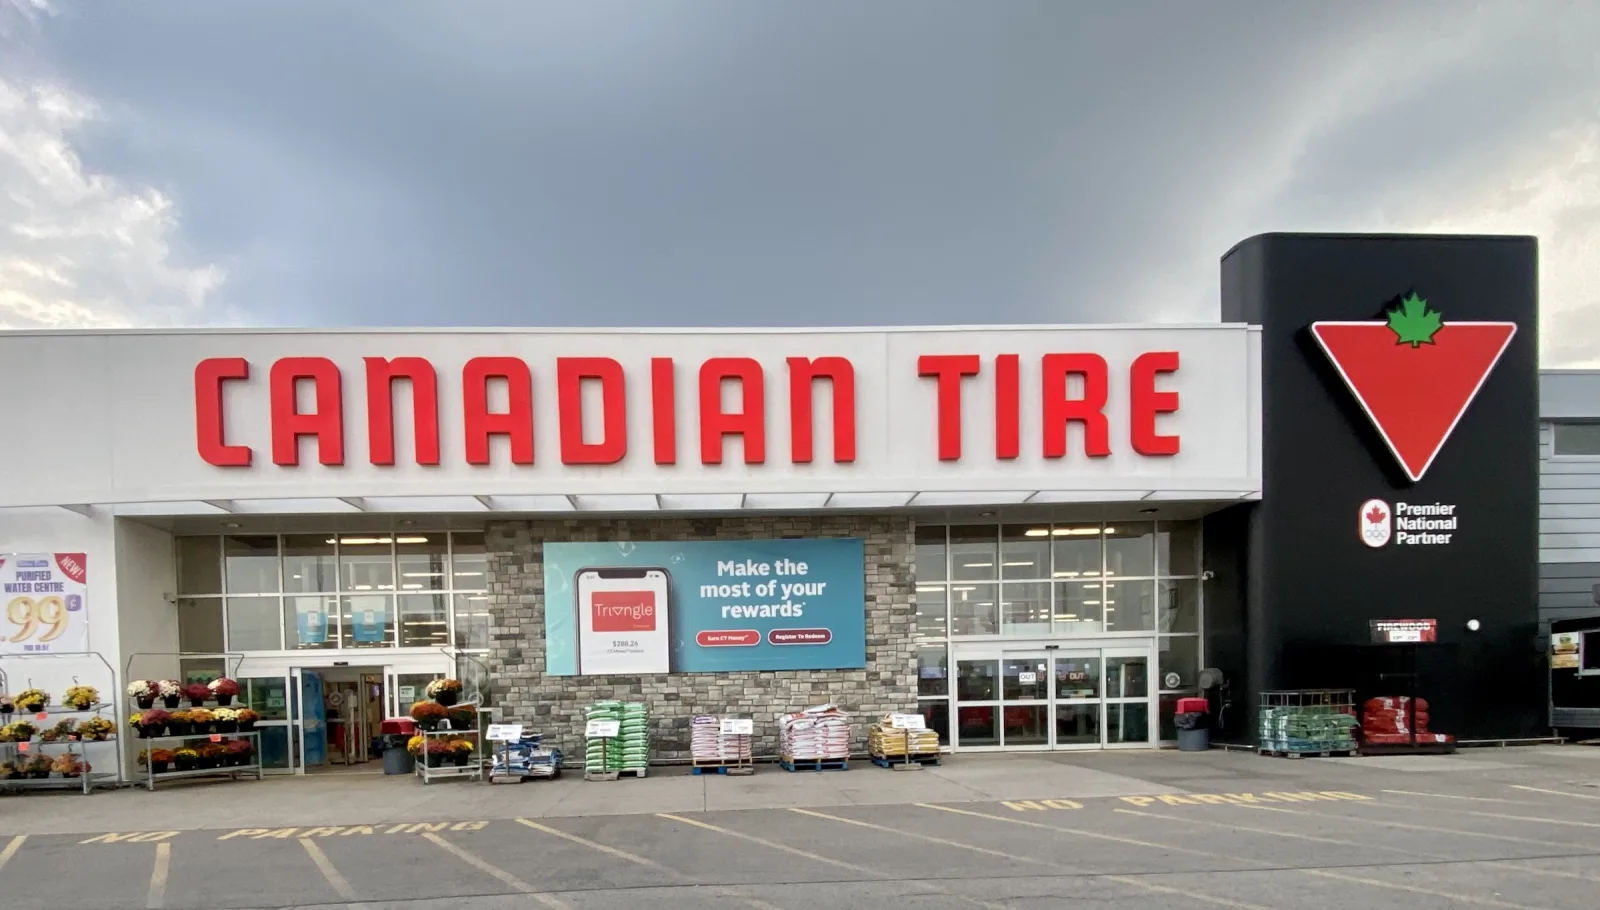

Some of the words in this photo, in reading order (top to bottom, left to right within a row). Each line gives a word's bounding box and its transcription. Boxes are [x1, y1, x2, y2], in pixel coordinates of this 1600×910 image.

[194, 356, 856, 467] CANADIAN
[917, 351, 1181, 461] TIRE
[1396, 502, 1456, 516] Premier
[1396, 516, 1457, 530] National
[1396, 531, 1453, 544] Partner
[60, 555, 85, 579] NEW!
[717, 559, 771, 577] Make
[774, 558, 808, 575] the
[16, 570, 52, 581] PURIFIED
[4, 582, 32, 593] WATER
[34, 581, 65, 593] CENTRE
[700, 581, 751, 598] most
[755, 579, 778, 597] of
[781, 582, 826, 600] your
[775, 633, 796, 641] Register
[1069, 672, 1084, 680] OUT
[1000, 799, 1084, 811] NO
[1119, 791, 1375, 807] PARKING
[78, 831, 181, 844] NO
[216, 820, 490, 840] PARKING
